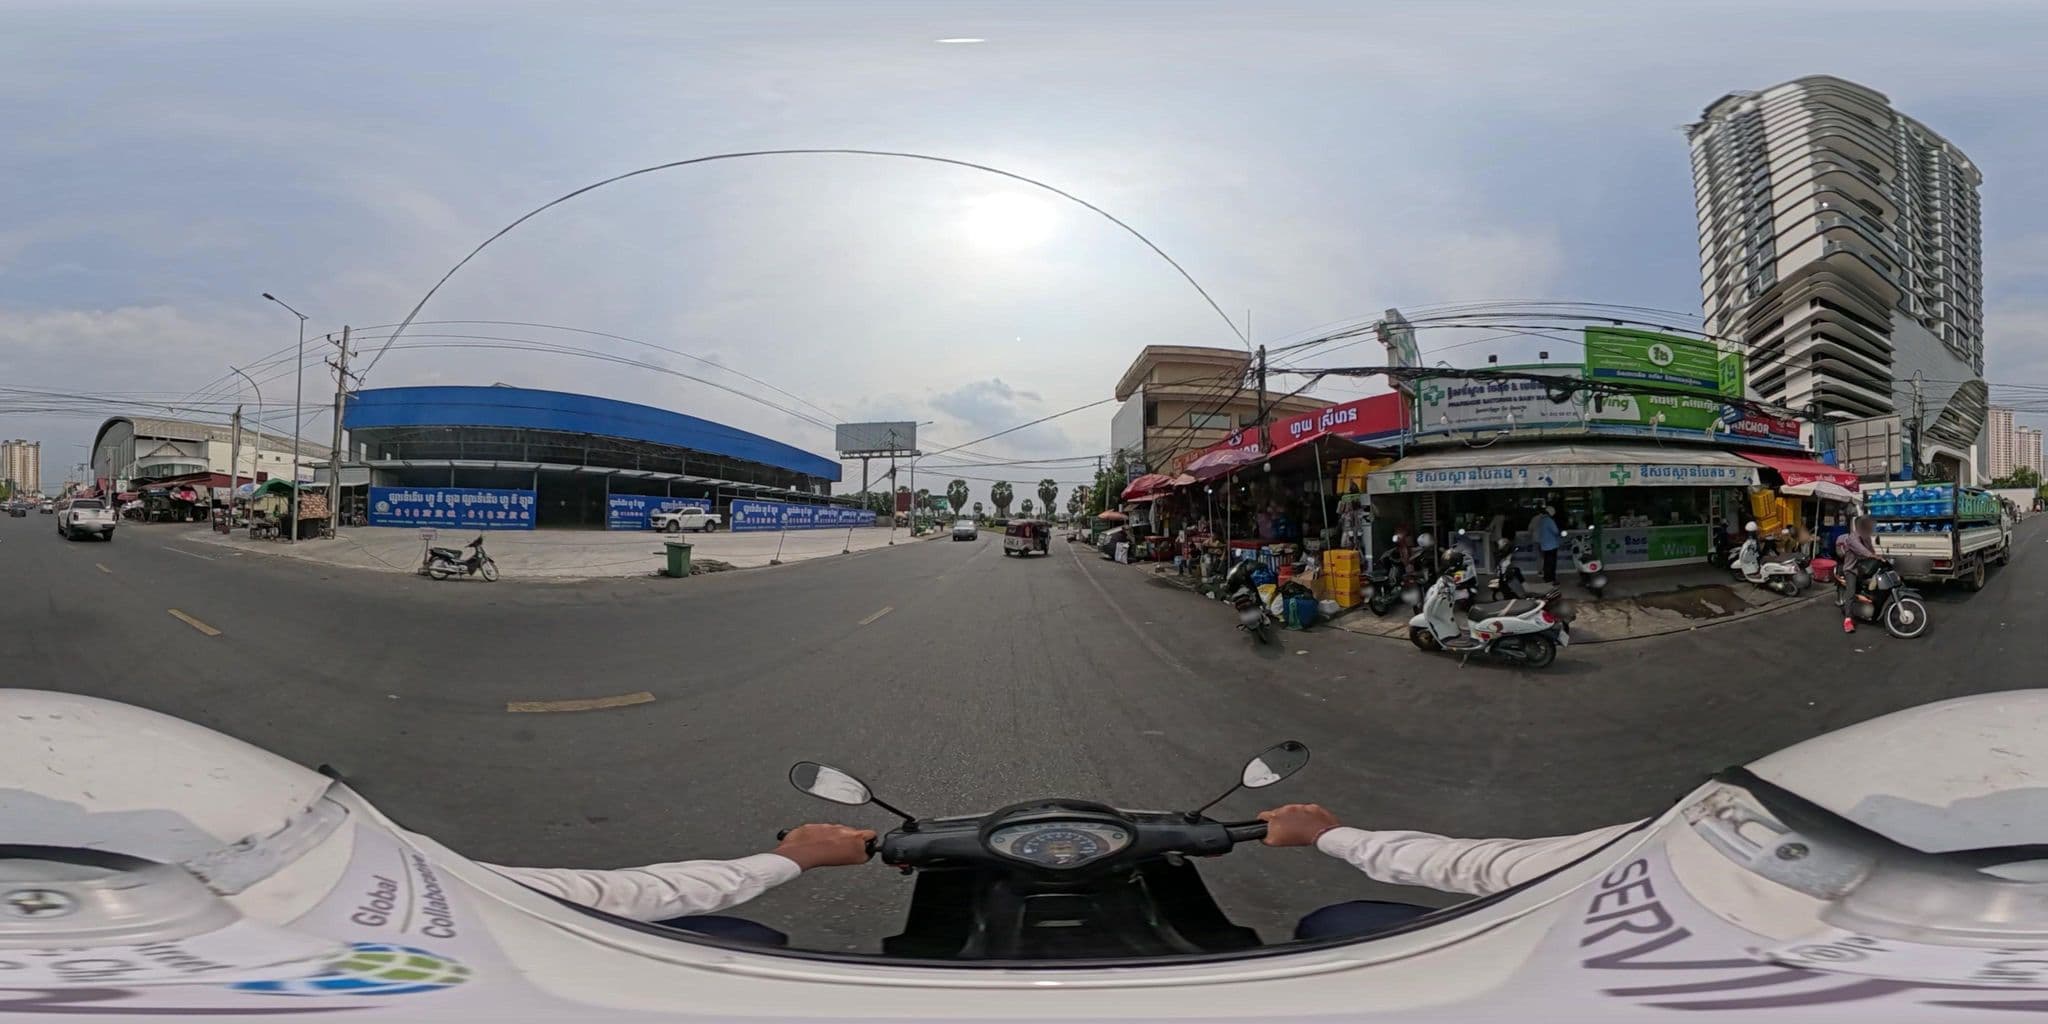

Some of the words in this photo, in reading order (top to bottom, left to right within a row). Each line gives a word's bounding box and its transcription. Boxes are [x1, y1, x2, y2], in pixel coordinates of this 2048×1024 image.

[1731, 420, 1770, 434] ANCHOR
[1662, 543, 1696, 557] Wing
[352, 874, 398, 927] Global
